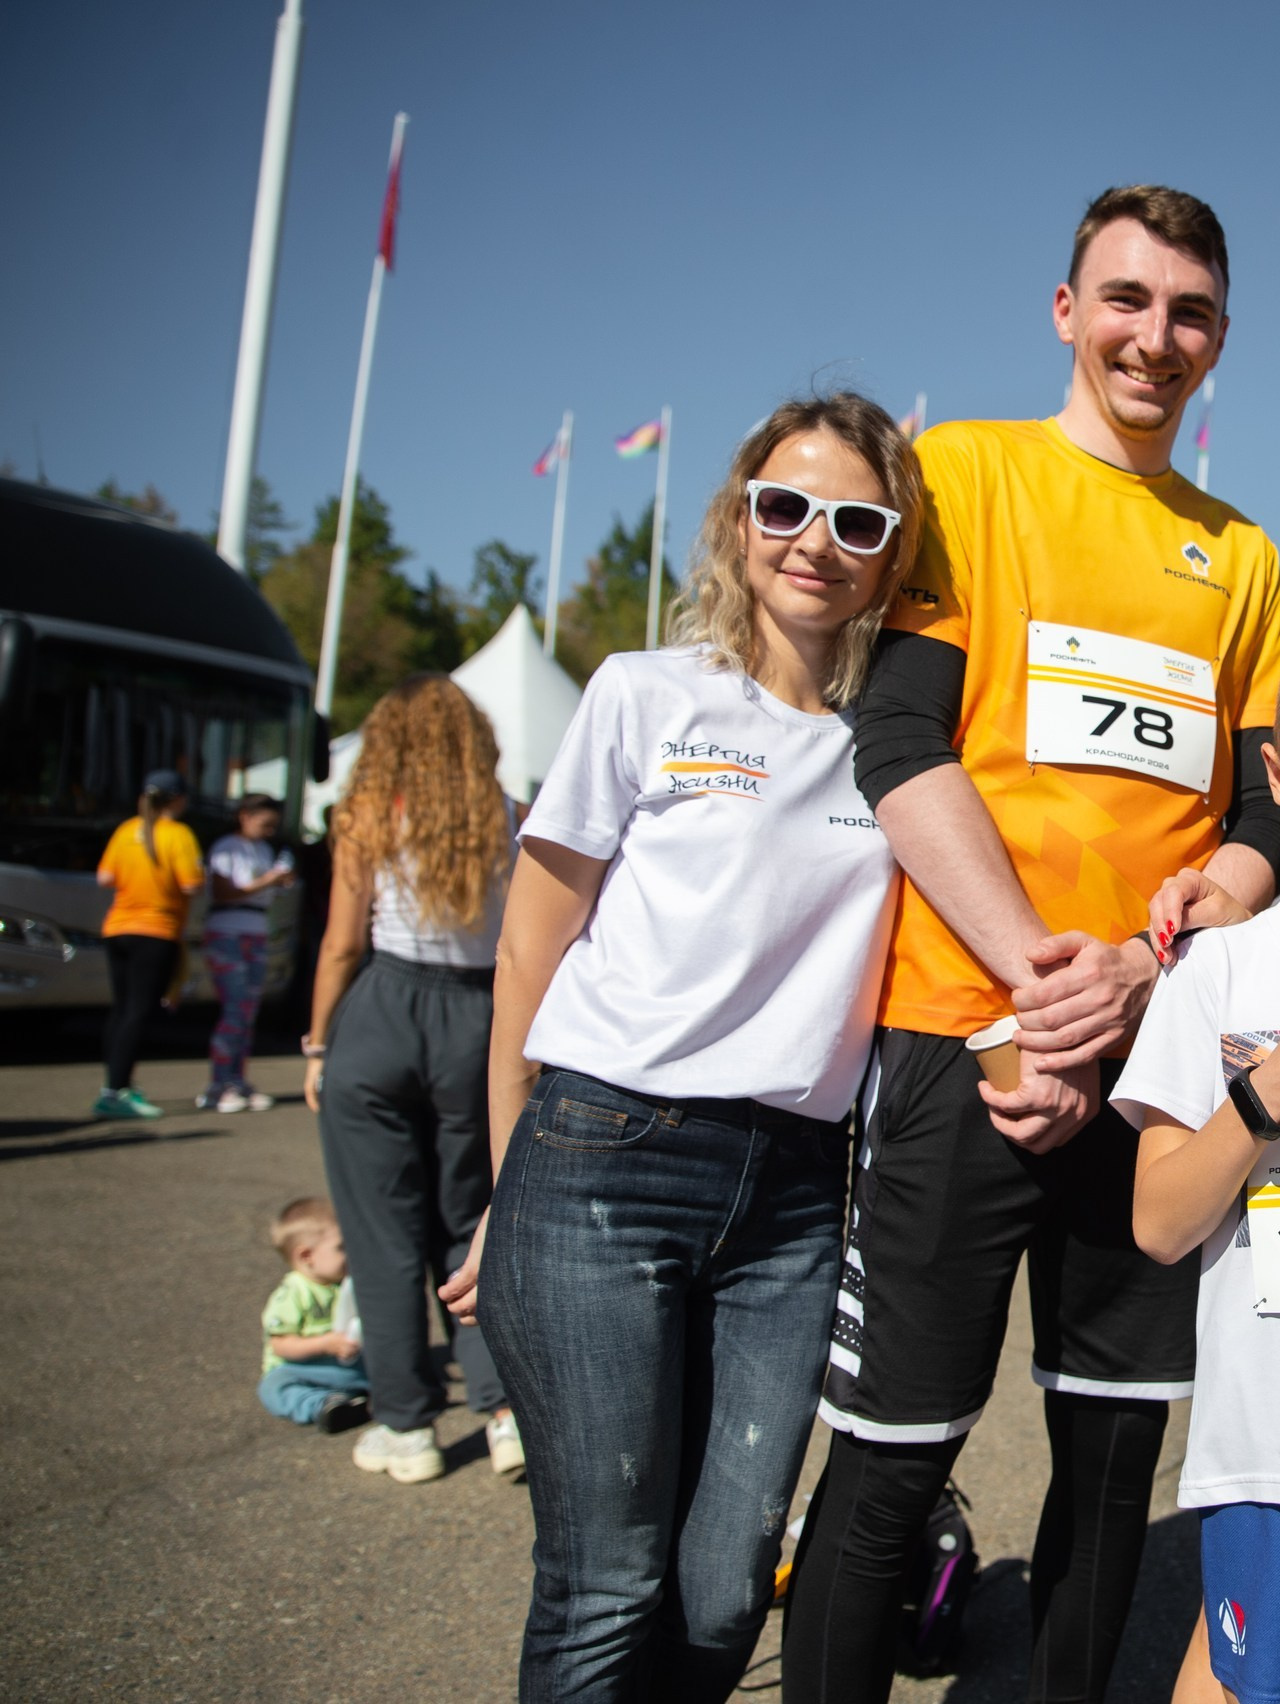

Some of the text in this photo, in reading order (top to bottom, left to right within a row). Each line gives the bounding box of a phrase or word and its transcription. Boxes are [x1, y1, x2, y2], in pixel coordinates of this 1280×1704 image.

[1164, 567, 1231, 599] РОСНЕФТЬ
[1081, 694, 1175, 751] 78
[1086, 748, 1170, 771] КРАСНОДАР 2024
[829, 816, 883, 831] РОСН
